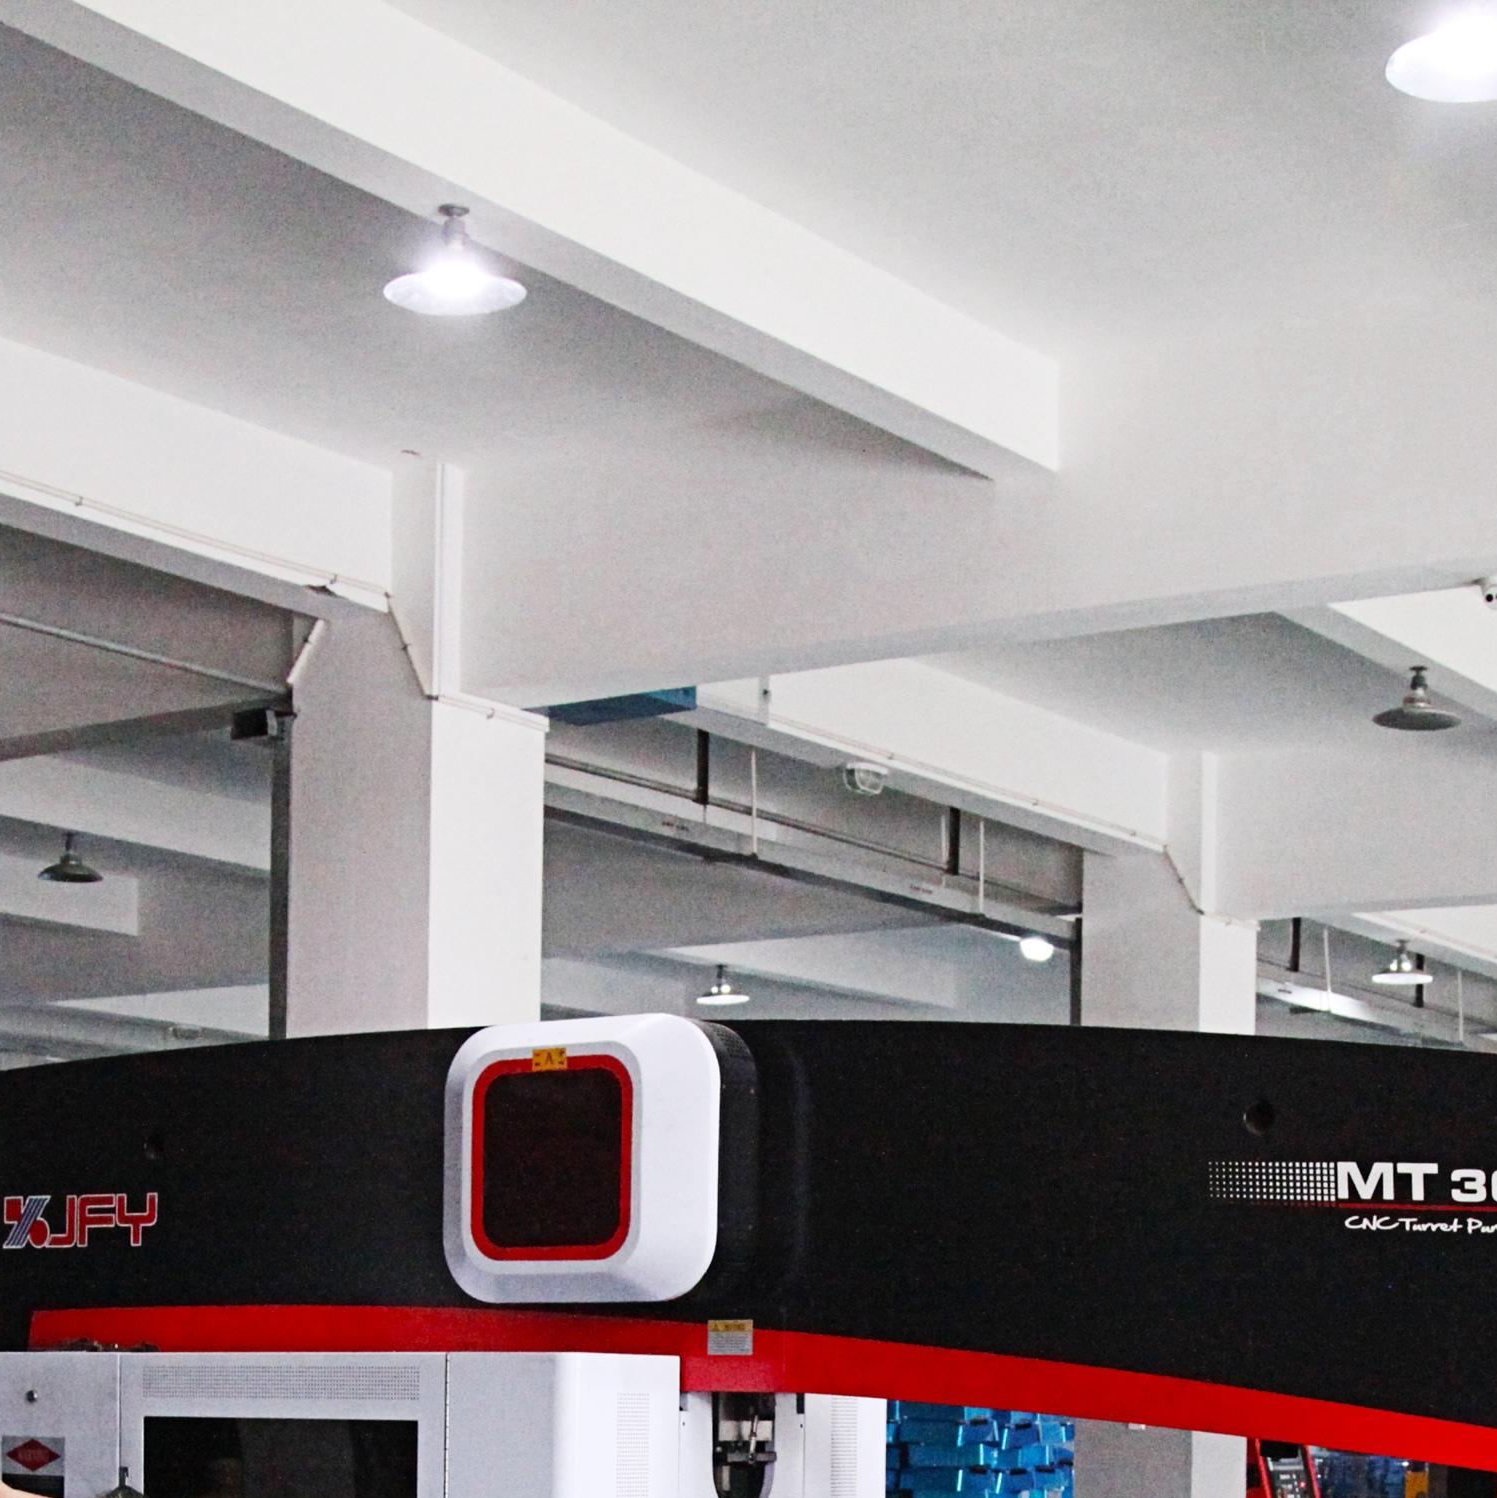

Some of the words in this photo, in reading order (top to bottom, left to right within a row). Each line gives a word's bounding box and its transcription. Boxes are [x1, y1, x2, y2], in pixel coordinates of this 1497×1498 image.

[1336, 1161, 1439, 1201] MT
[45, 1192, 159, 1249] JFY
[1344, 1215, 1400, 1232] CNC
[1399, 1216, 1464, 1234] Turret
